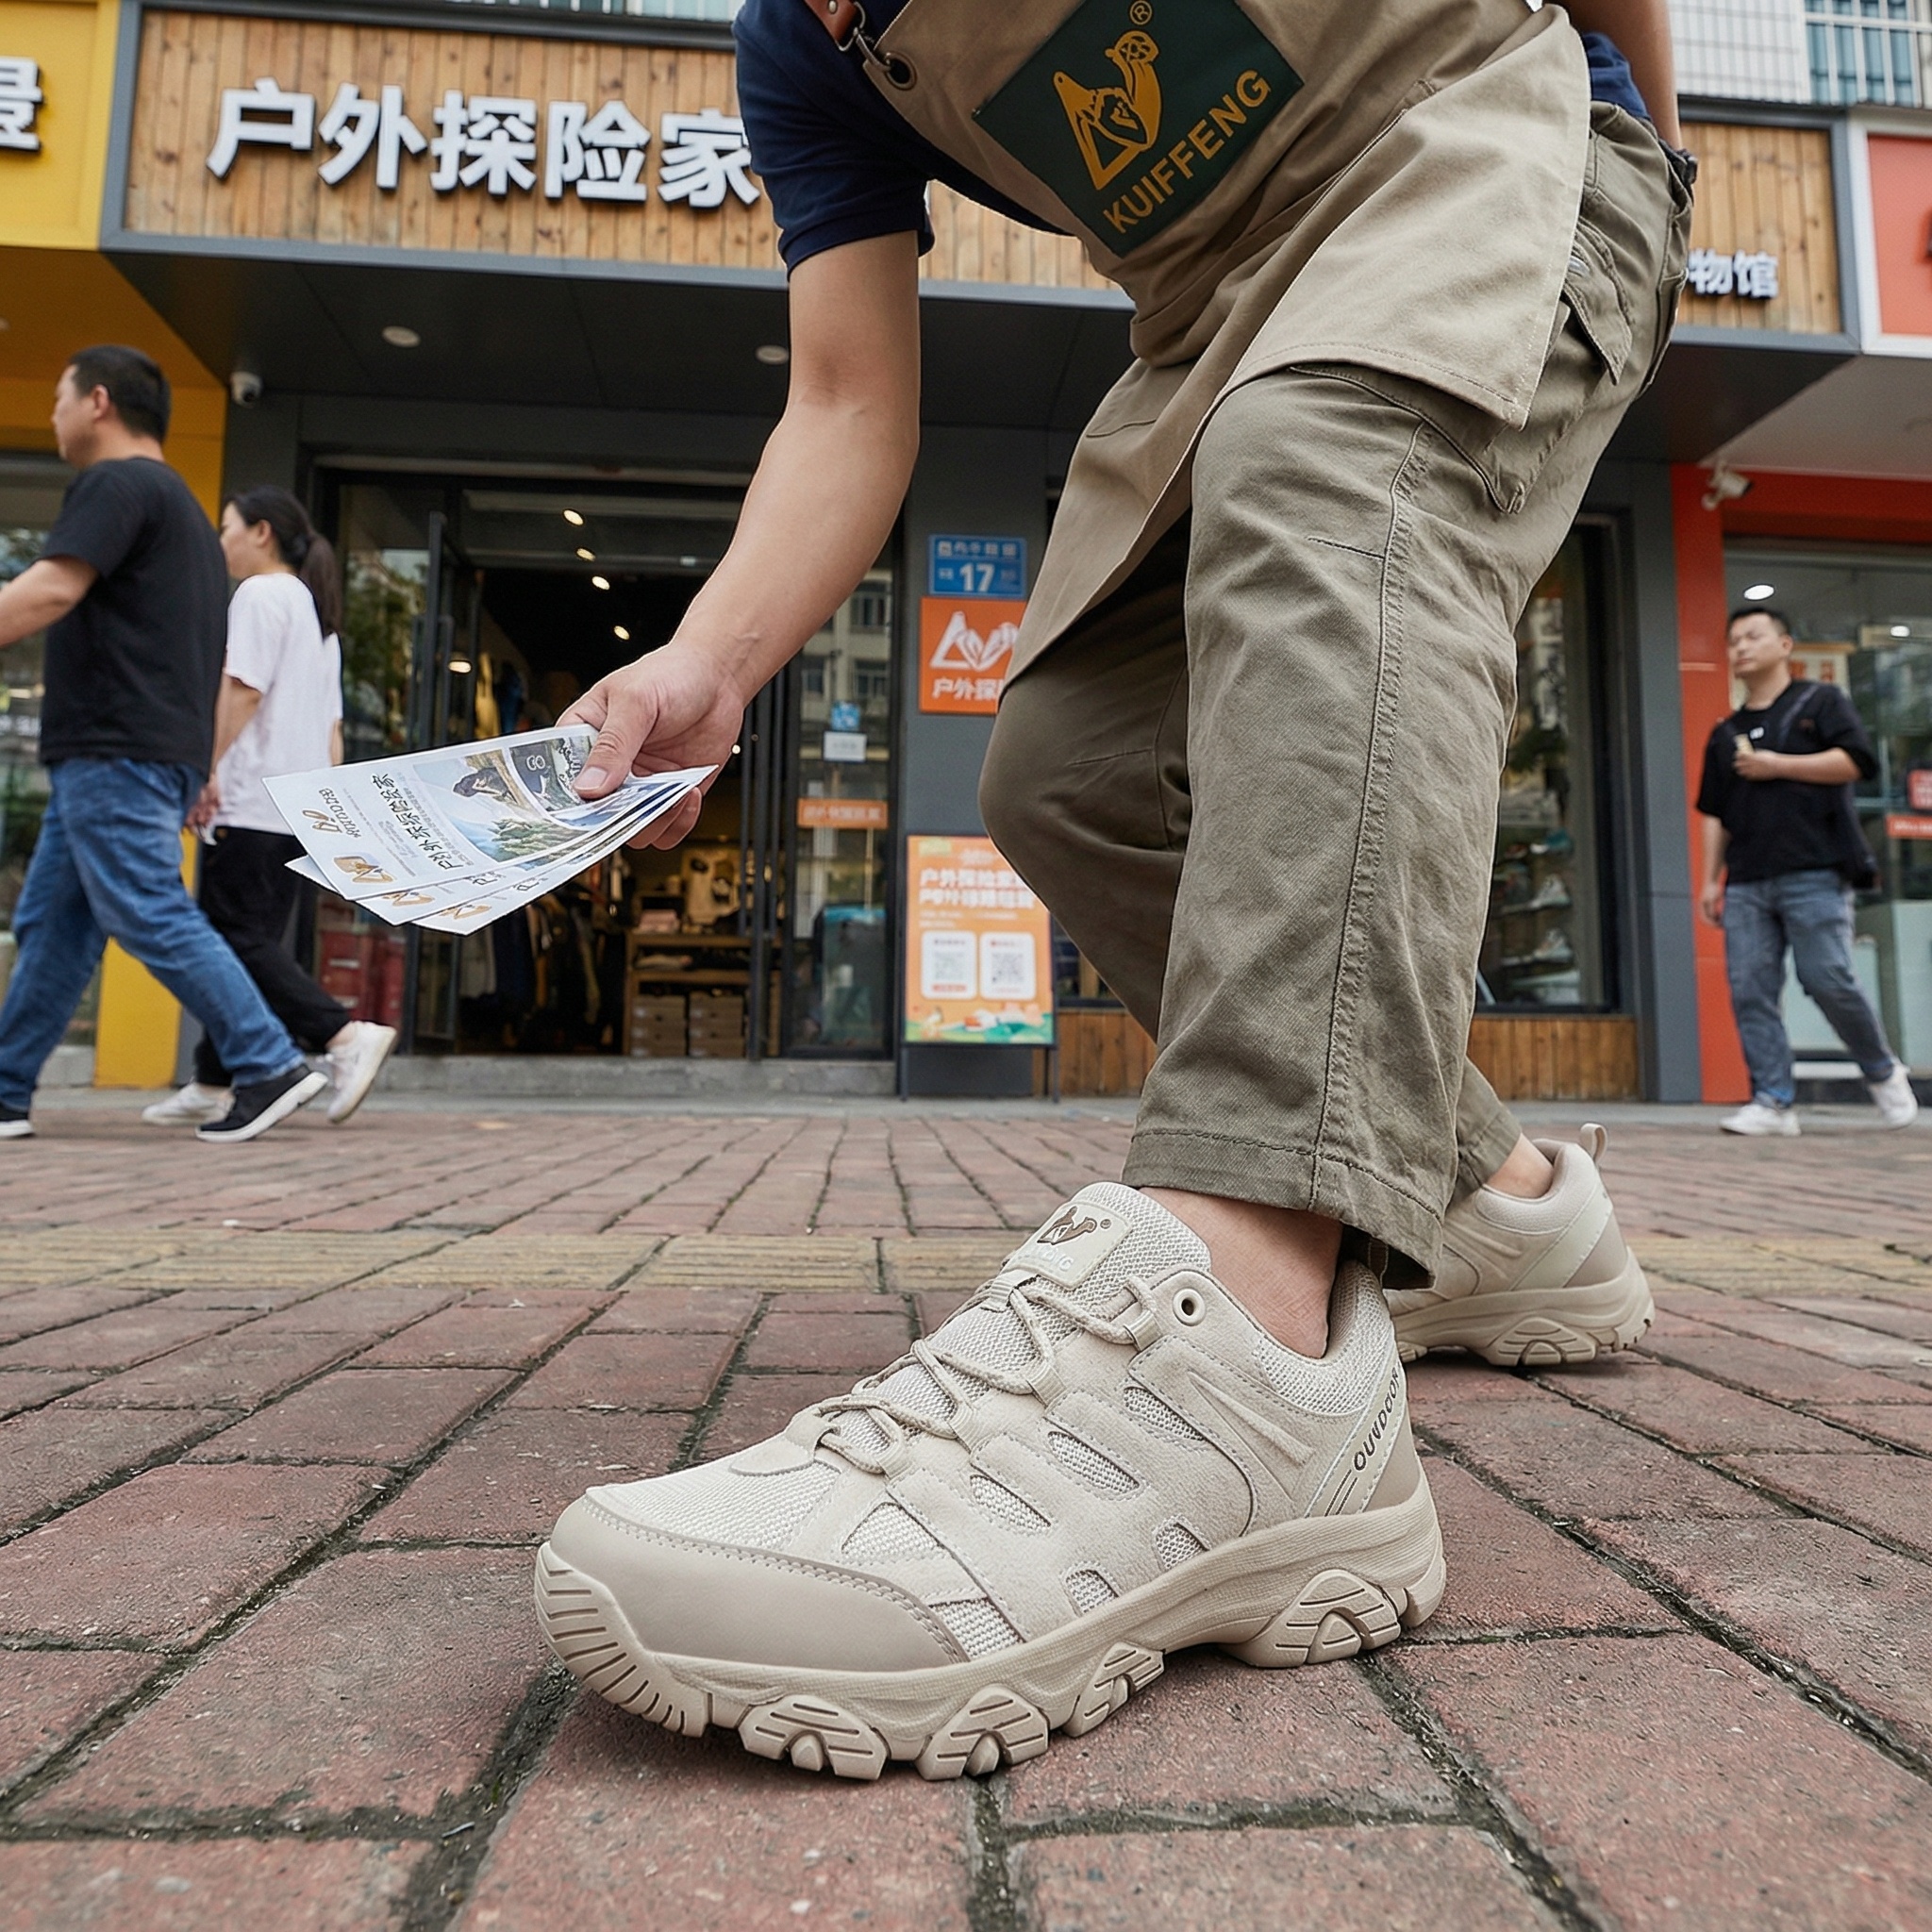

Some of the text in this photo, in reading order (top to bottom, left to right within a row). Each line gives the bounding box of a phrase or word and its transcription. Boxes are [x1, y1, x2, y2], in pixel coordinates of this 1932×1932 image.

[206, 77, 761, 208] 户外探险家
[1103, 69, 1272, 234] KUIFFENG
[959, 562, 995, 592] 17
